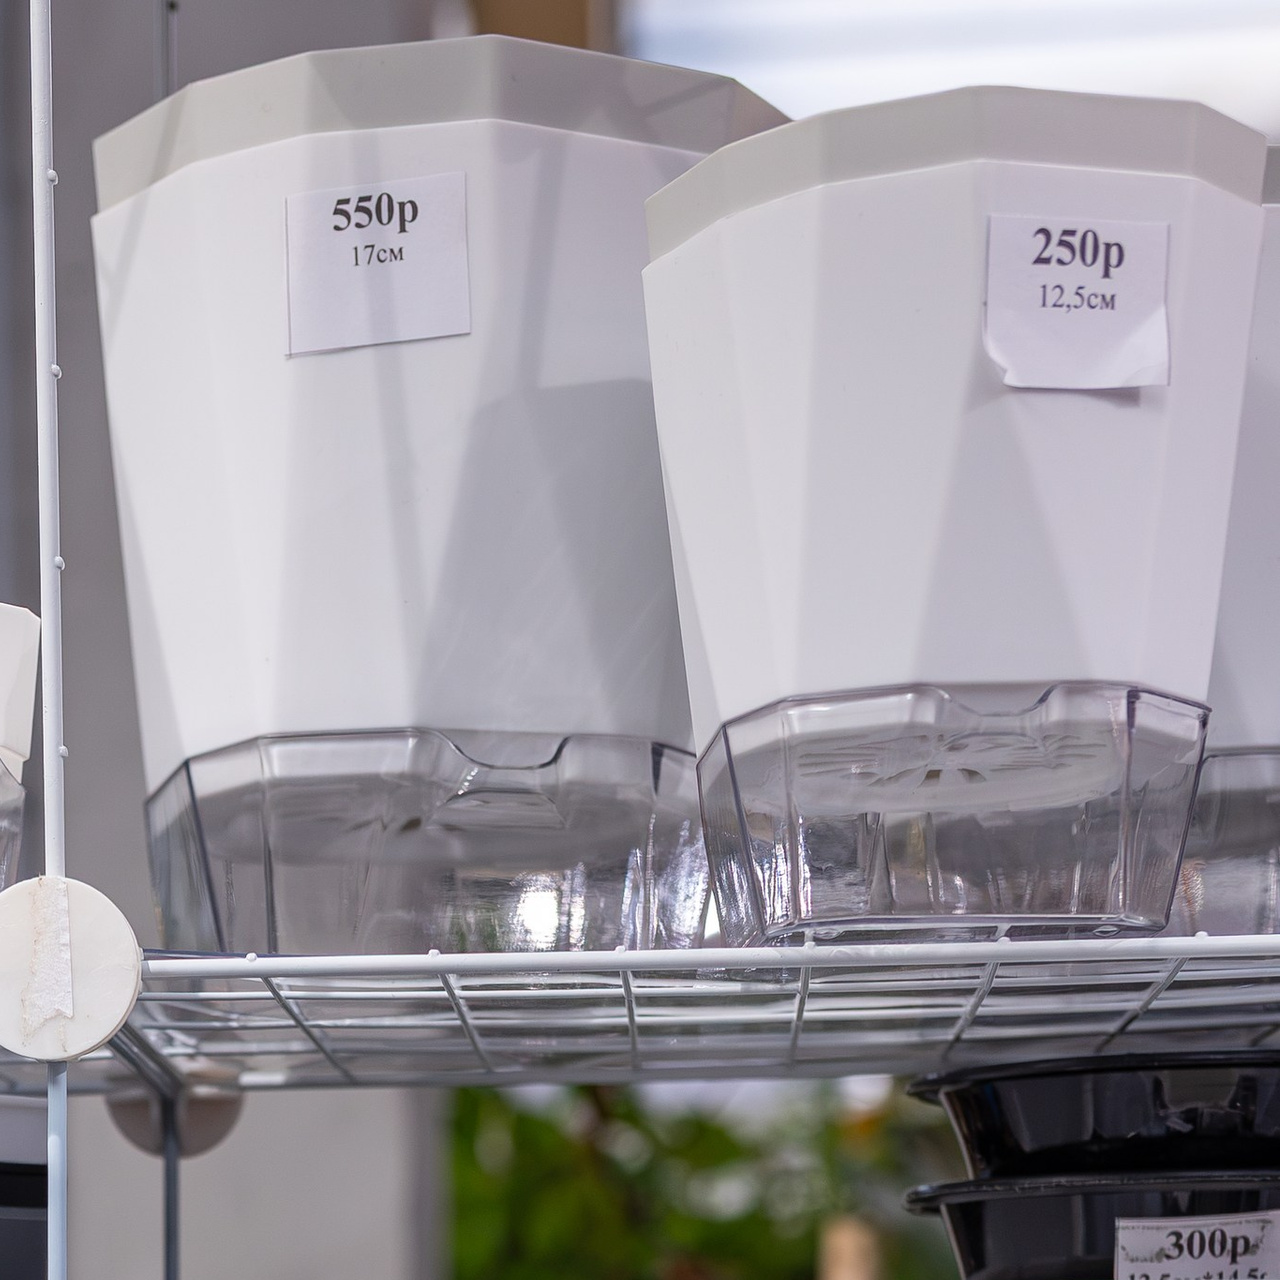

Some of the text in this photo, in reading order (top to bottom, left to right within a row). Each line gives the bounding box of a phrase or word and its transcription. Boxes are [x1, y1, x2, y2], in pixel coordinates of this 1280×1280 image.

[332, 191, 419, 233] 550р
[351, 242, 405, 268] 17см
[1031, 228, 1124, 279] 250р
[1038, 284, 1117, 312] 12,5см
[1164, 1228, 1251, 1265] 300р
